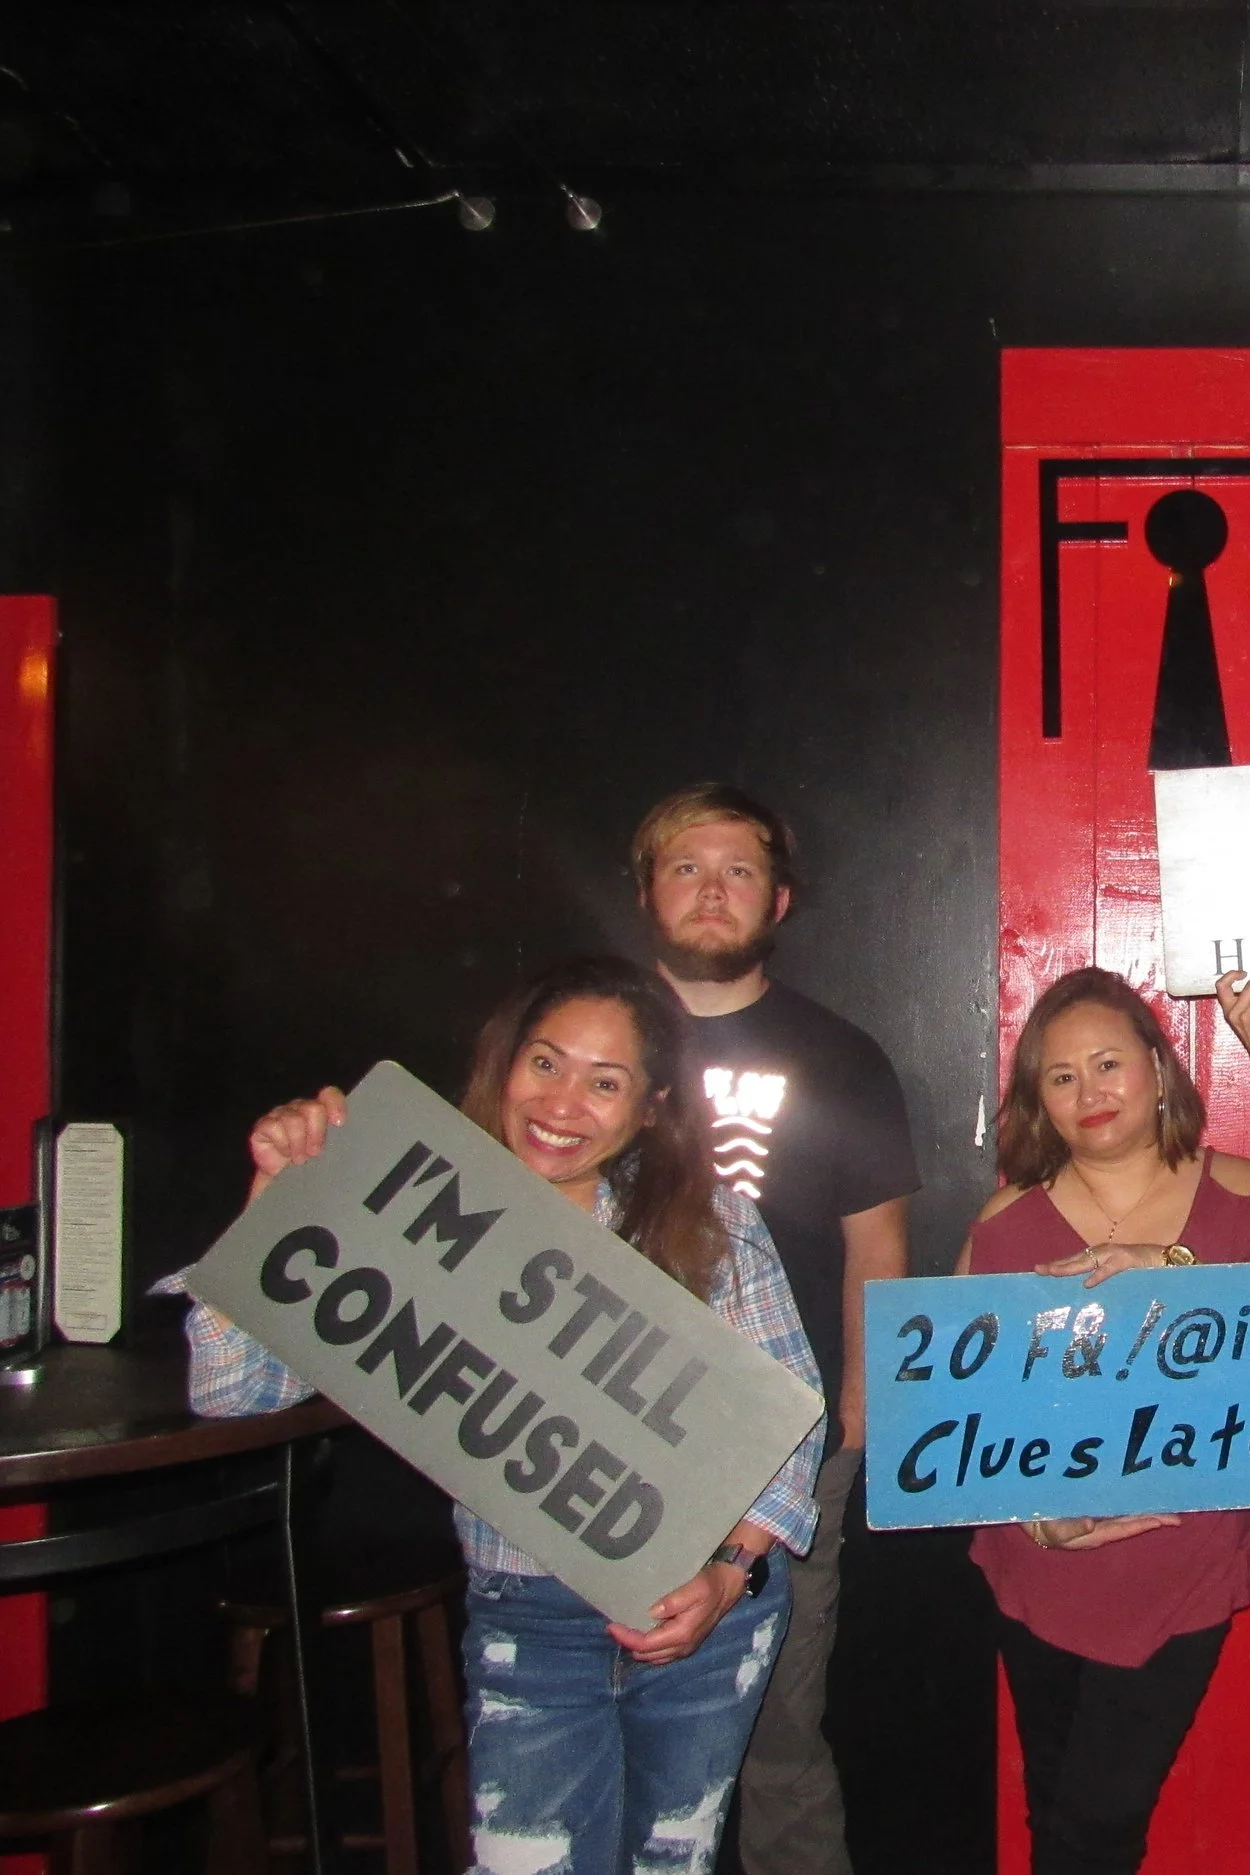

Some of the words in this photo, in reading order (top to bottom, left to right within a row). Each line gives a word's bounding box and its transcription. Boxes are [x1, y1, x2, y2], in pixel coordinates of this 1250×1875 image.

[362, 1140, 508, 1273] I'M
[499, 1248, 711, 1448] STILL
[894, 1312, 999, 1383] 20
[259, 1224, 666, 1561] CONFUSED
[897, 1412, 1105, 1494] Clues
